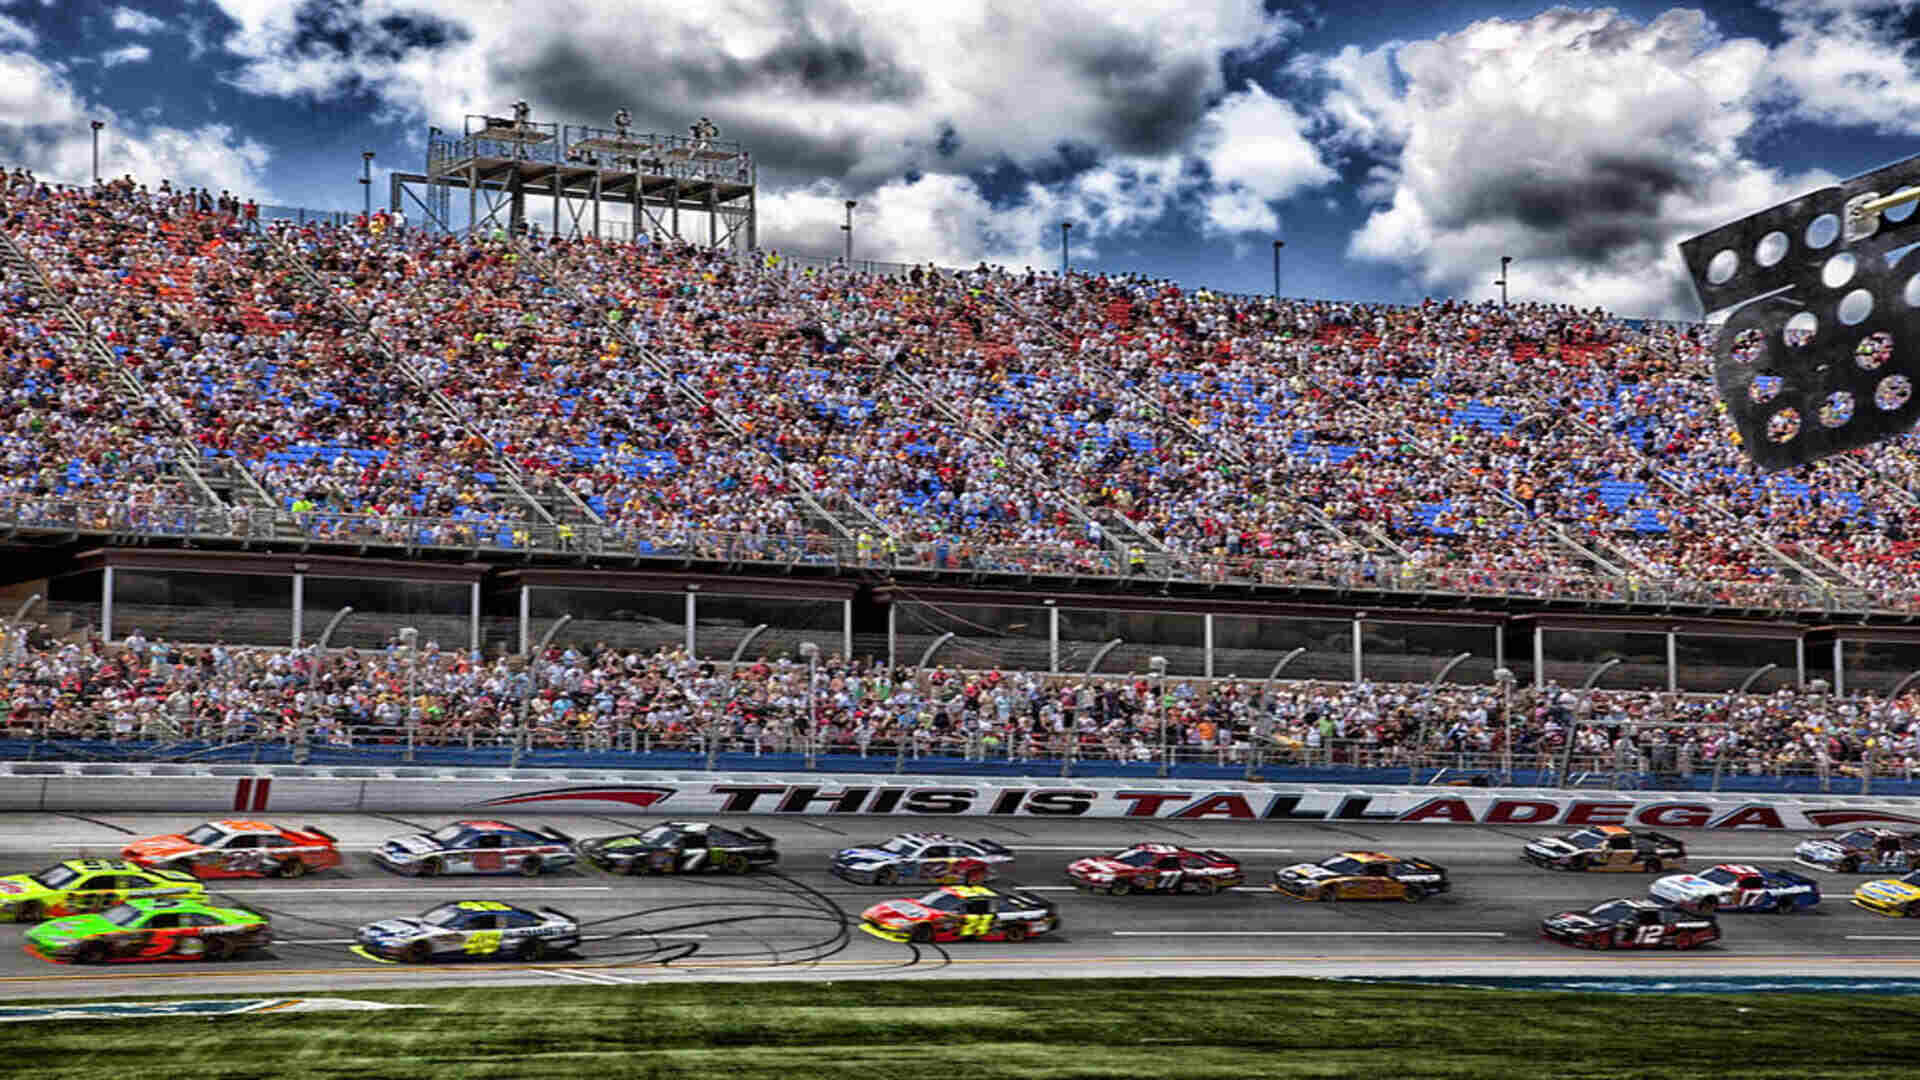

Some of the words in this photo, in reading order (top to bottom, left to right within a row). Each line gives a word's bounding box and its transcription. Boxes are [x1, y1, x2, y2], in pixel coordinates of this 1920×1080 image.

[711, 785, 977, 815] THIS
[986, 787, 1098, 816] IS
[1114, 790, 1786, 829] TALLADEGA
[682, 849, 707, 871] 7
[1739, 889, 1765, 906] 17
[1634, 925, 1665, 945] 12
